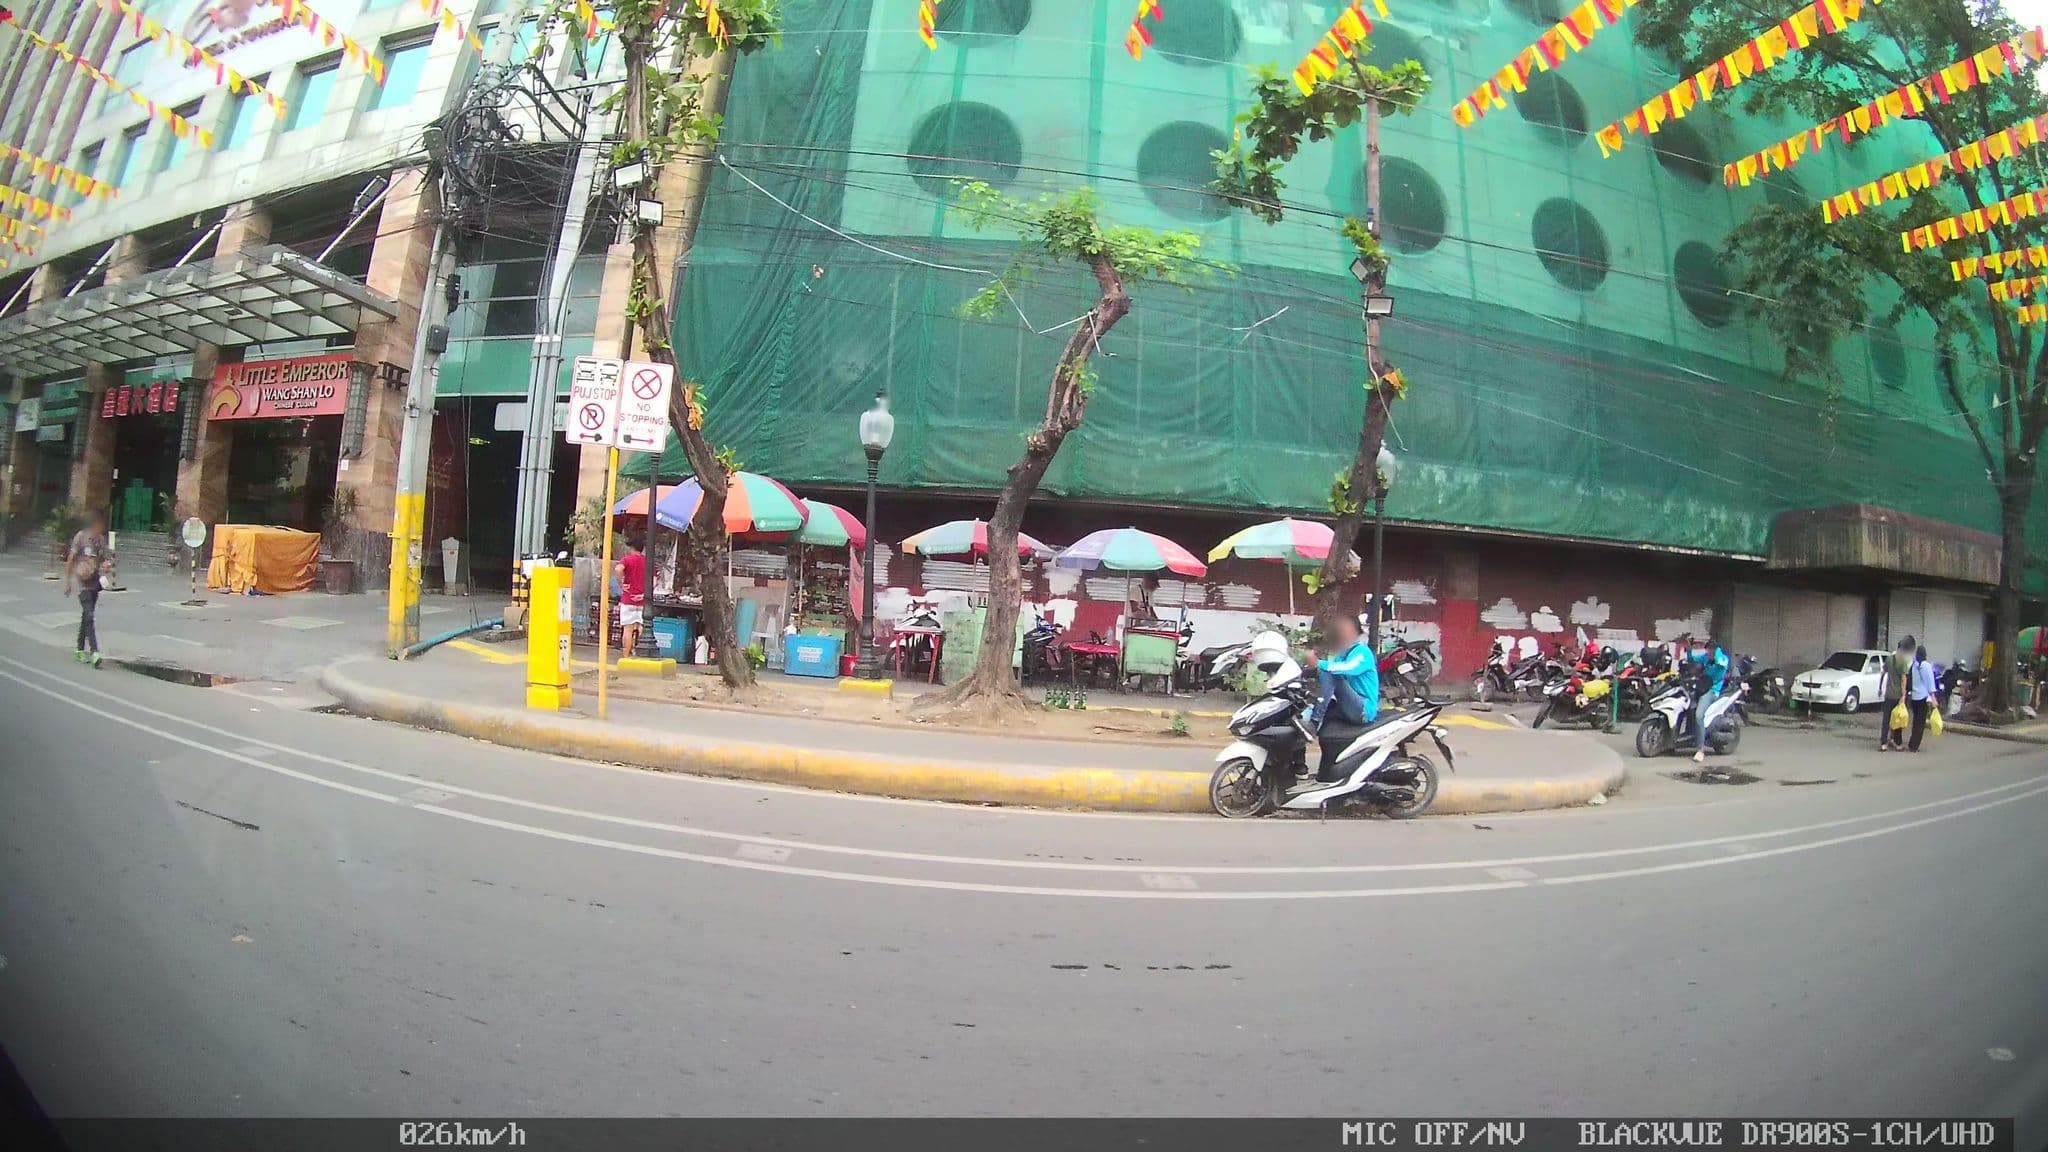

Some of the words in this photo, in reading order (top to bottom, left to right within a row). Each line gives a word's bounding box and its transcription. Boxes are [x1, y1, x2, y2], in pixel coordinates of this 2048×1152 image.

[239, 364, 277, 386] LITTLE
[280, 360, 349, 383] EMPEROR
[263, 386, 290, 401] WANG
[319, 384, 334, 399] LO
[593, 387, 617, 401] STOP
[636, 402, 651, 412] NO
[619, 412, 664, 426] STOPPING
